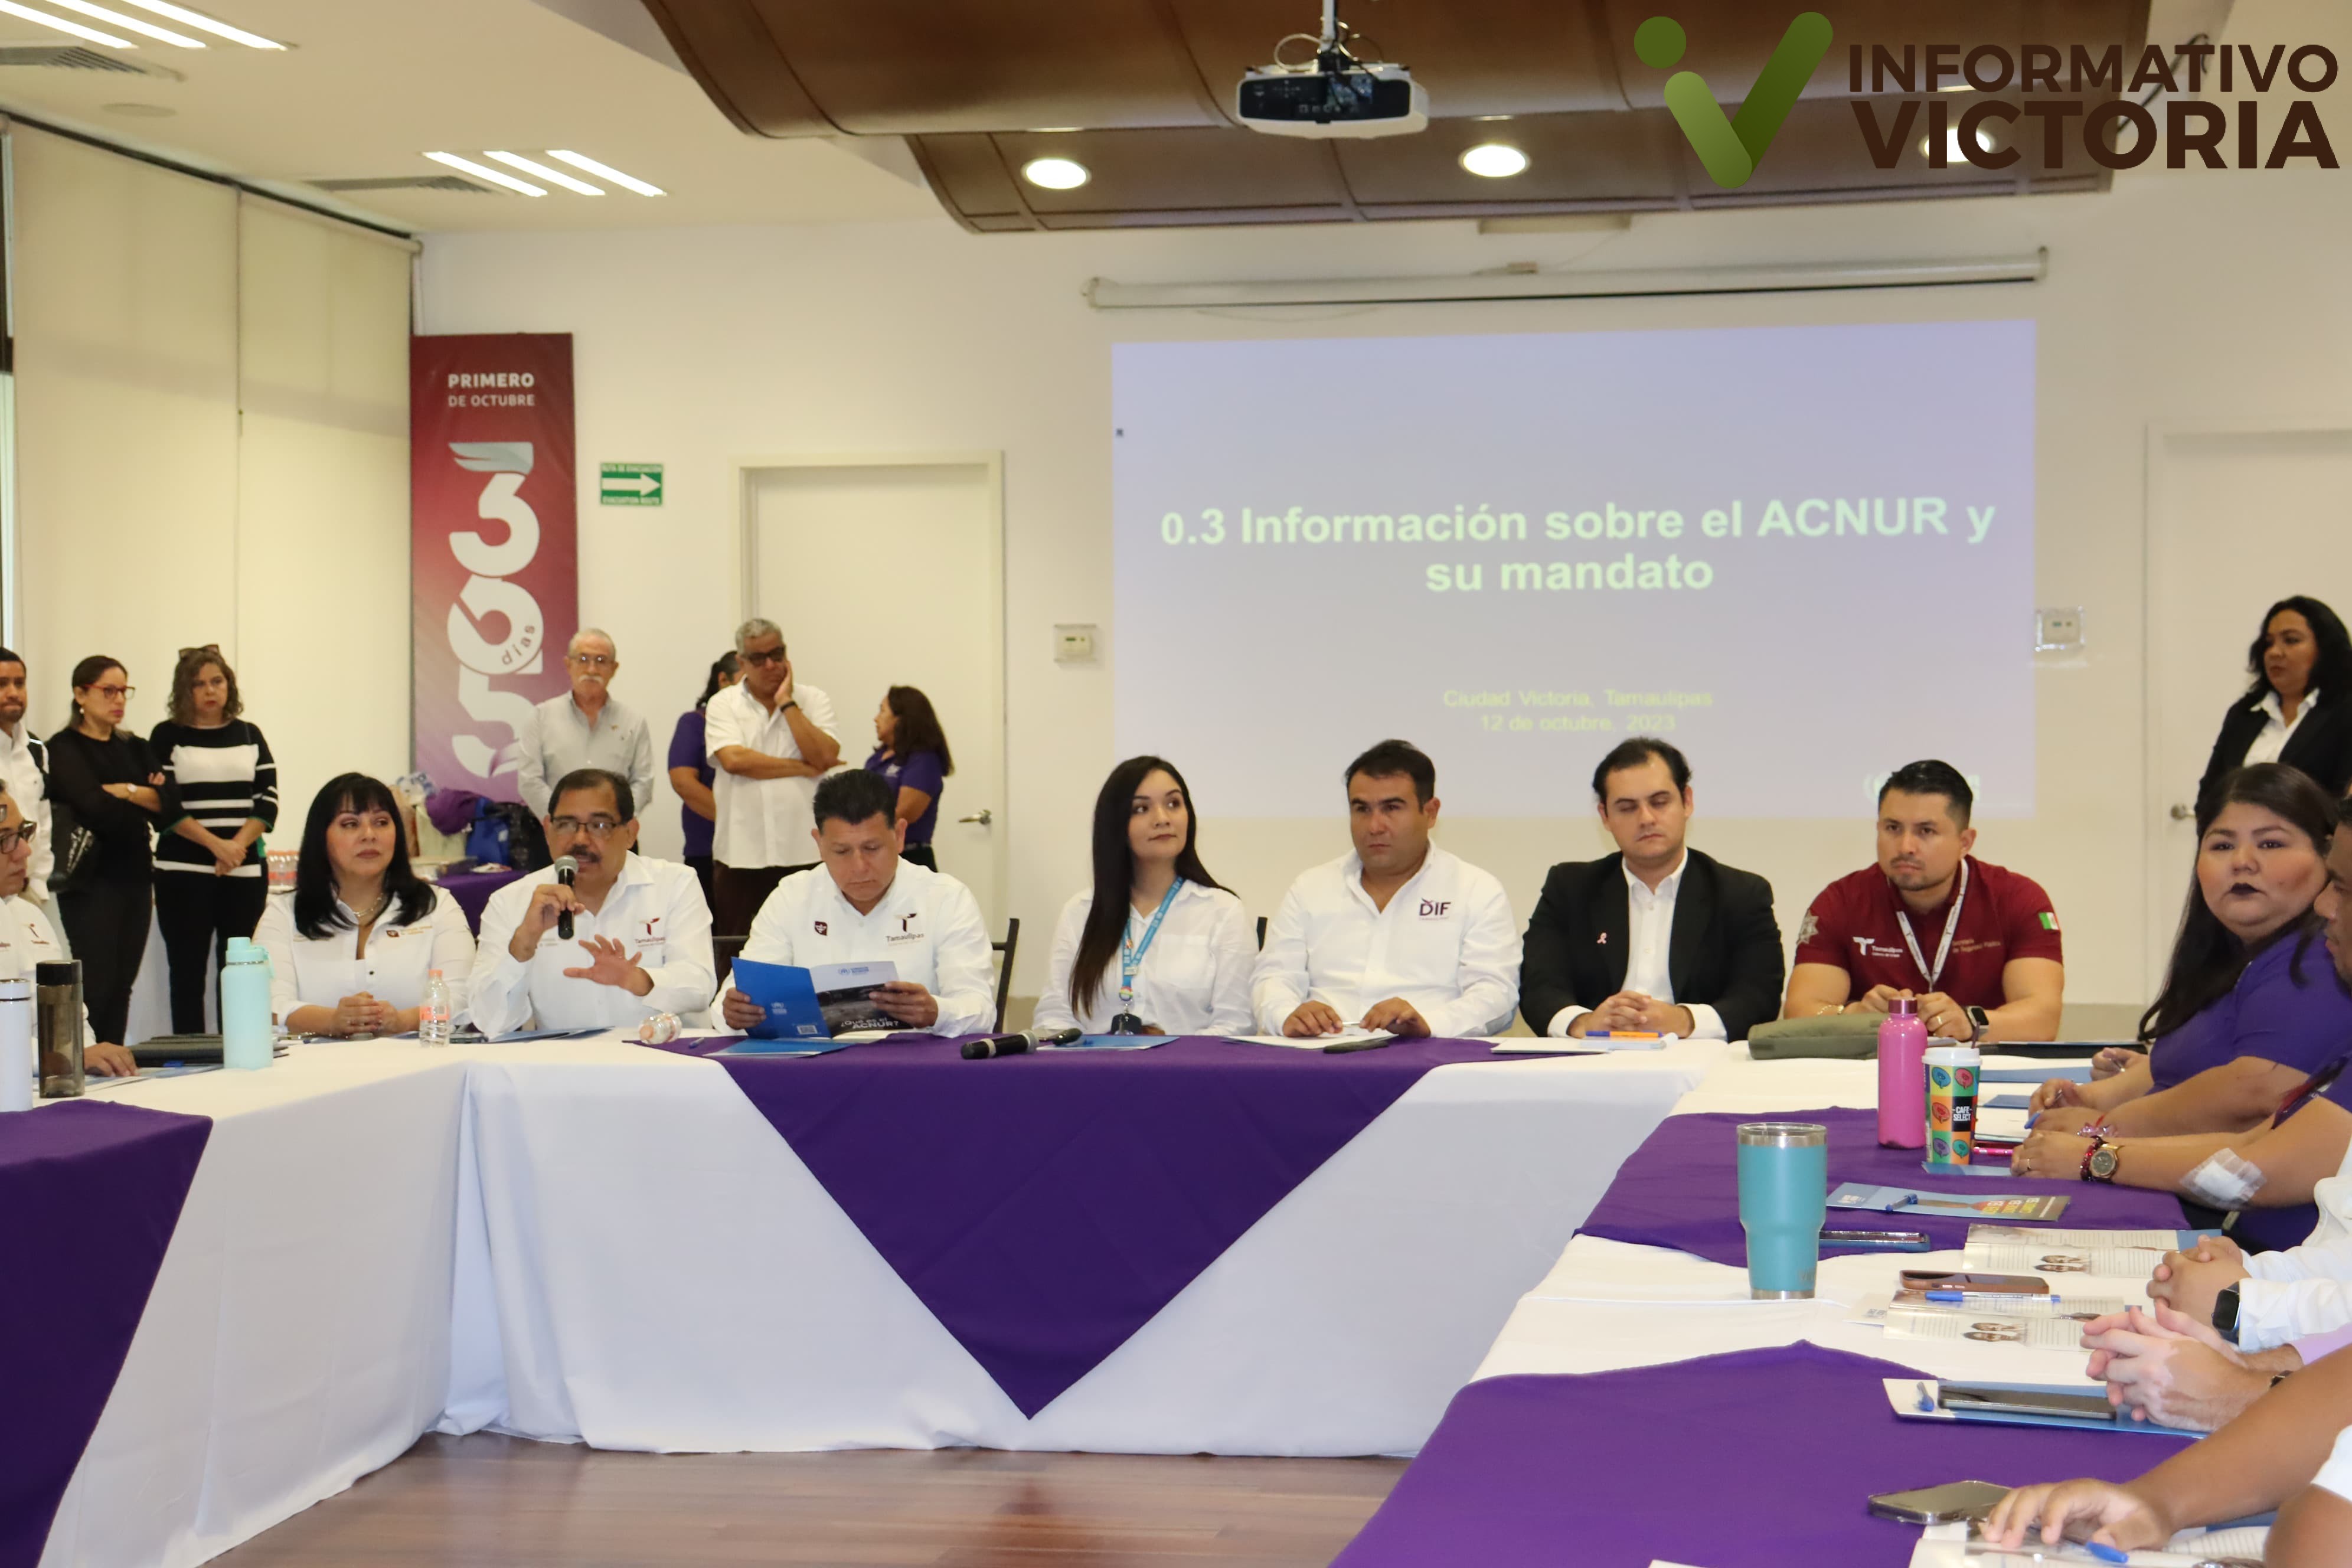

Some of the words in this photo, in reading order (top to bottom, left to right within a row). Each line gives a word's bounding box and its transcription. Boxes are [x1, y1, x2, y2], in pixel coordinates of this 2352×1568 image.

[448, 373, 534, 388] PRIMERO
[448, 395, 466, 407] DE
[471, 394, 535, 407] OCTUBRE
[1161, 508, 1225, 545] 0.3
[1242, 504, 1527, 543] Información
[1545, 502, 1684, 540] sobre
[1701, 500, 1742, 537] el
[1757, 498, 1949, 537] ACNUR
[1967, 505, 1995, 544] y
[1425, 563, 1482, 592] su
[1501, 553, 1713, 590] mandato
[1443, 690, 1511, 707] Ciudad
[1605, 689, 1713, 710] Tamaulipas
[1481, 715, 1504, 731] 12
[1509, 715, 1533, 731] de
[1626, 714, 1677, 731] 2023
[1419, 901, 1452, 916] DIF
